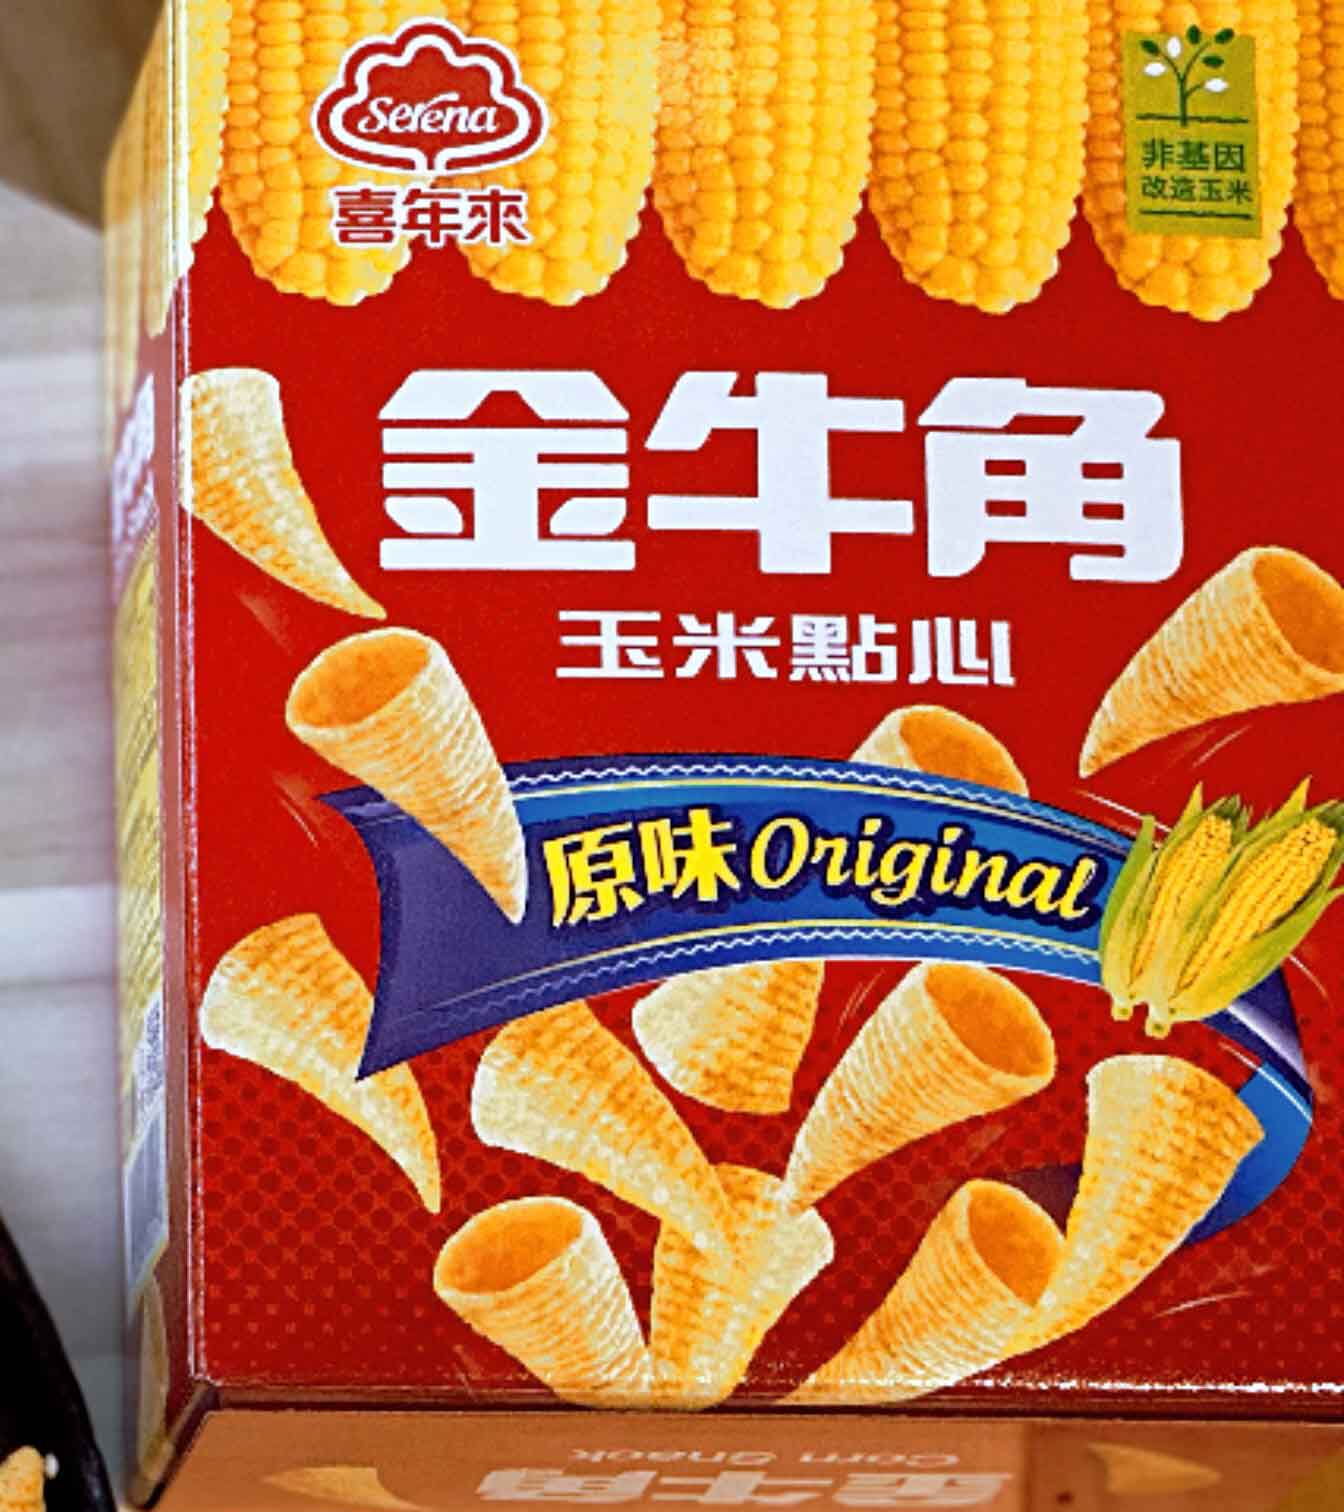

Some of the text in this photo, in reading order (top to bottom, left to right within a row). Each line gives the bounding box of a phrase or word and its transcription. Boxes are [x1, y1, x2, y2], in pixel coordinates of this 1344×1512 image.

[357, 91, 500, 133] Serena
[1141, 138, 1246, 172] 非基因
[1140, 175, 1253, 204] 改造玉米
[332, 186, 529, 243] 喜年來
[376, 369, 1185, 584] 金牛角
[555, 609, 1017, 688] 玉米點心
[541, 808, 1098, 929] 原味 Original
[572, 1447, 960, 1468] Corn Snack
